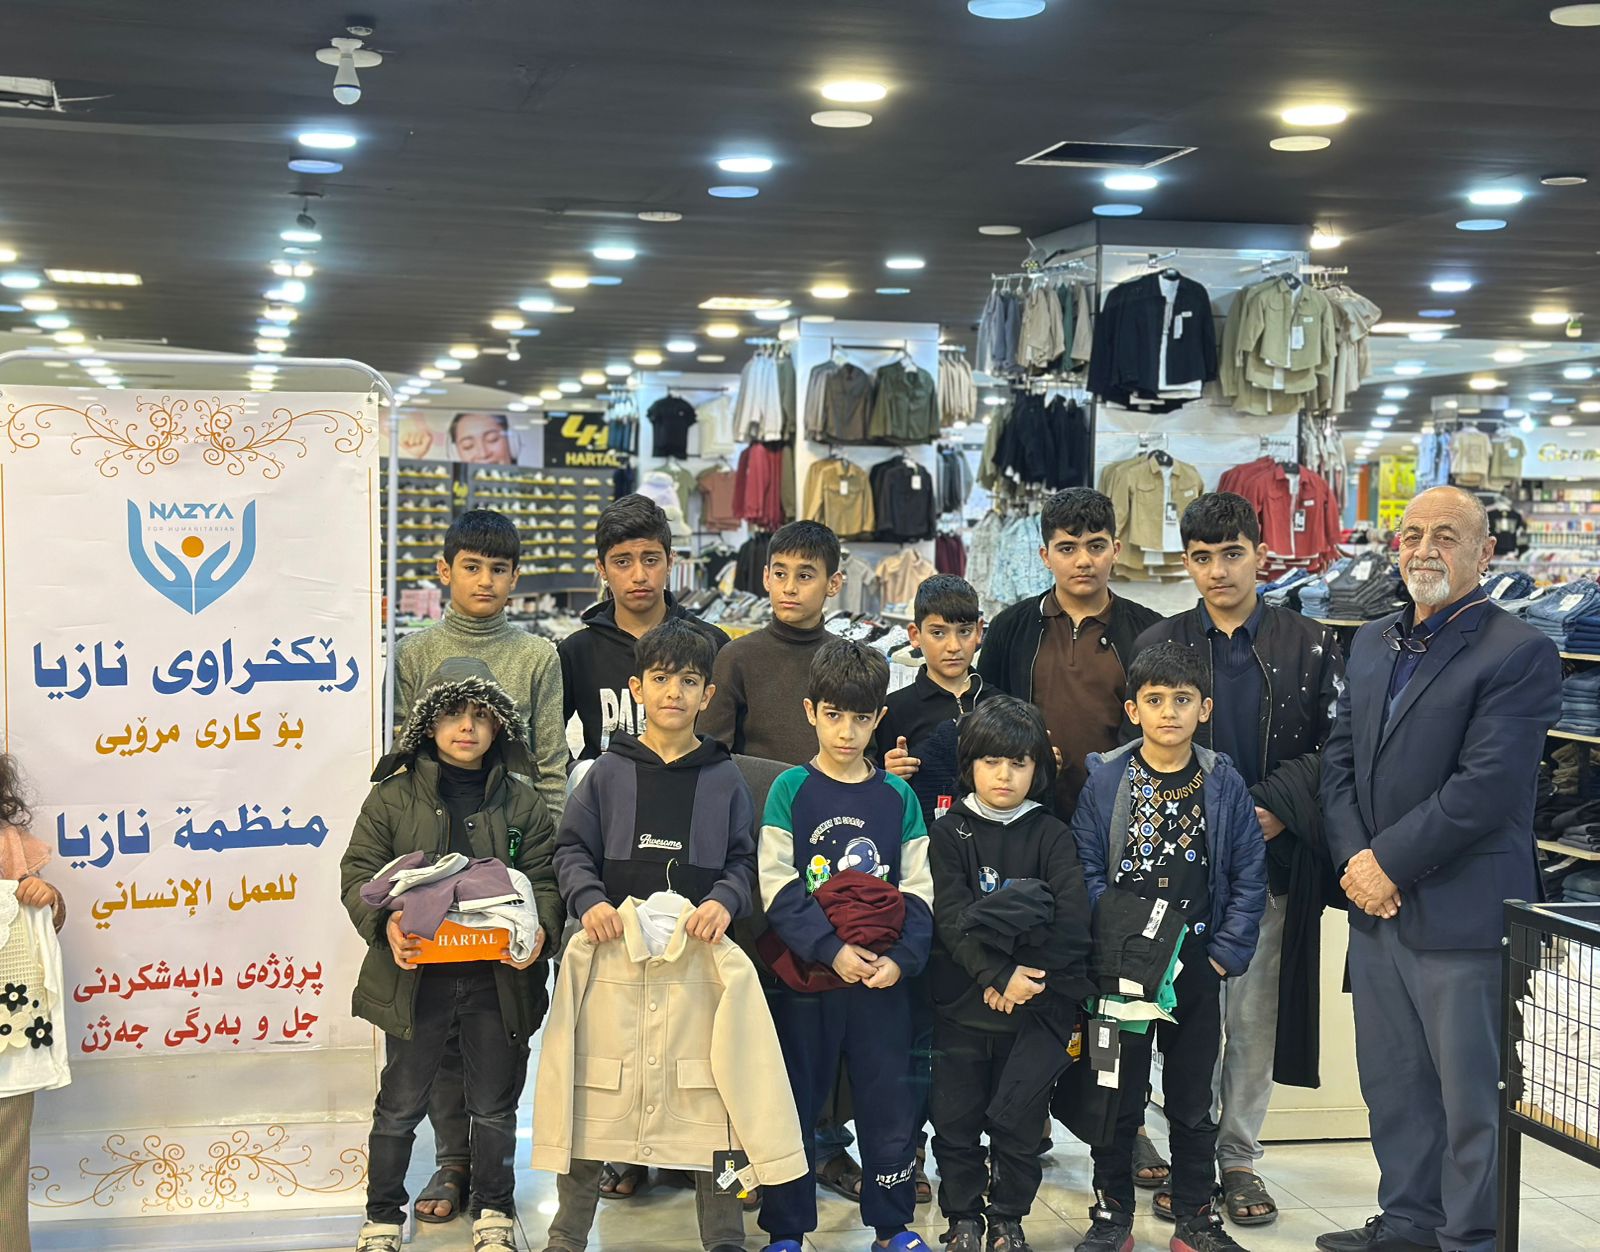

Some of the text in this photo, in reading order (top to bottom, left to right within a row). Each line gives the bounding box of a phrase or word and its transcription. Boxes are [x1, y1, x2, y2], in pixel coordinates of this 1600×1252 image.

[149, 501, 234, 520] NAZYA
[33, 636, 359, 700] رێکخراوی نازیا
[195, 711, 261, 749] کاری
[272, 712, 304, 750] بۆ
[173, 804, 329, 852] منظمة
[638, 833, 683, 850] Awesome
[92, 873, 298, 930] للعمل الإنساني
[438, 933, 497, 946] HARTAL
[163, 1006, 242, 1048] بەرگی
[252, 1014, 269, 1041] و
[282, 1005, 319, 1038] جل
